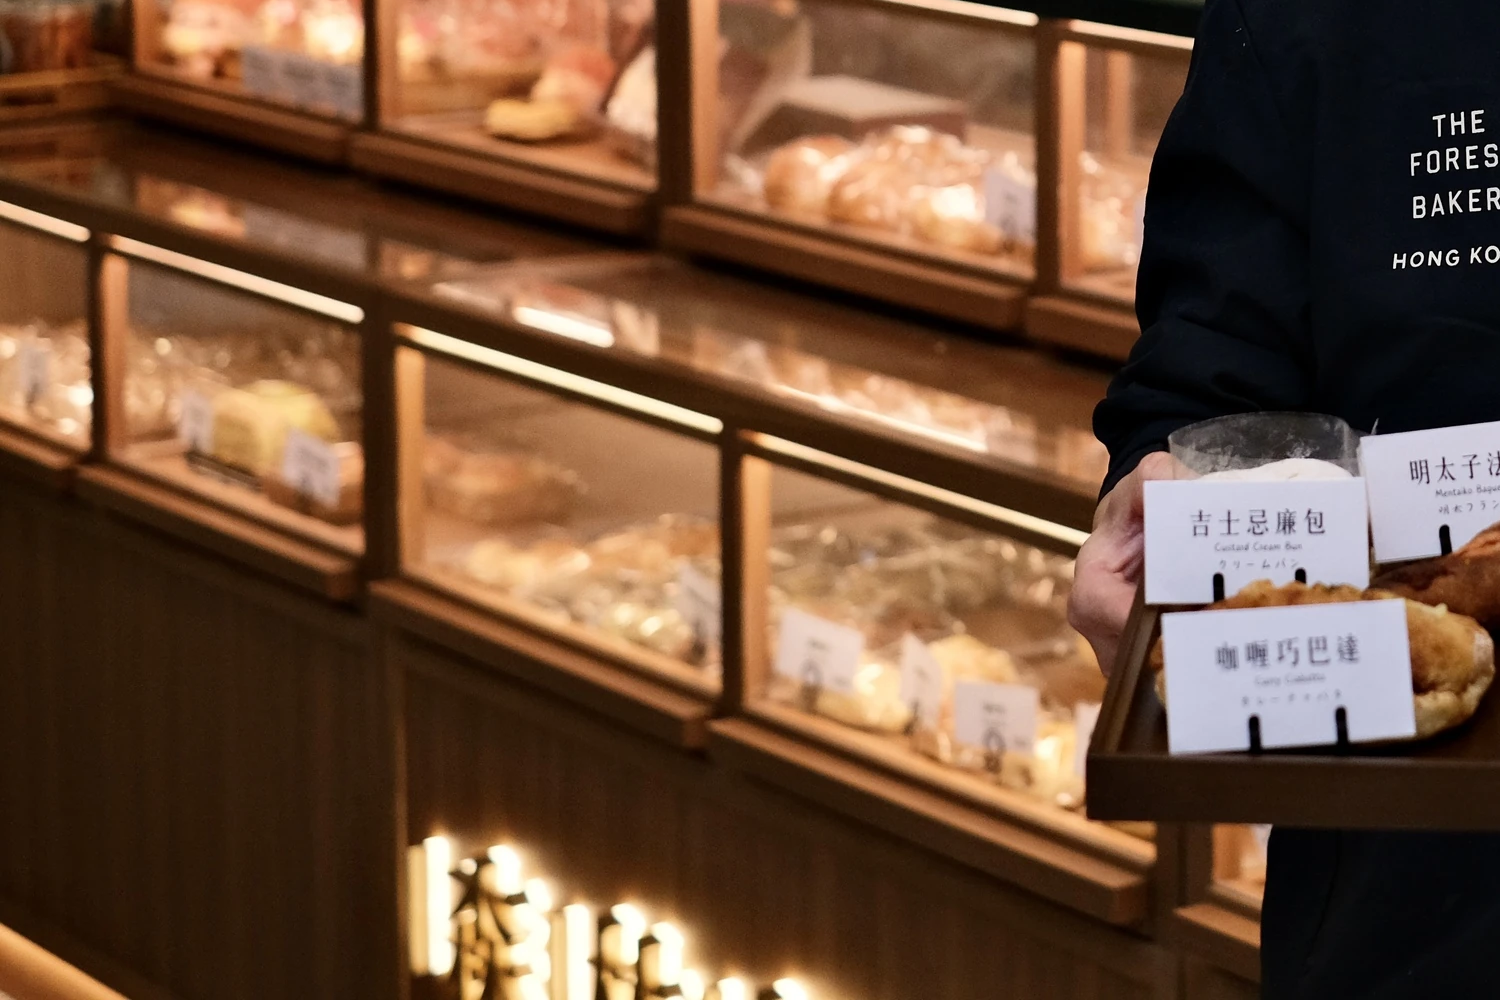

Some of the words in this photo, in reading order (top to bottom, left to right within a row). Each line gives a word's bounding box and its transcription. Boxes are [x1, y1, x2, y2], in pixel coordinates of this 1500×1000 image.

[1433, 109, 1486, 137] THE
[1392, 249, 1460, 270] HONG
[1435, 487, 1472, 497] Mentaiko
[1190, 508, 1326, 537] 吉士忌廉包
[1214, 542, 1249, 551] Custard
[1253, 542, 1280, 551] Cream
[1285, 542, 1303, 551] Bun
[1216, 633, 1359, 670] 咖喱巧巴達
